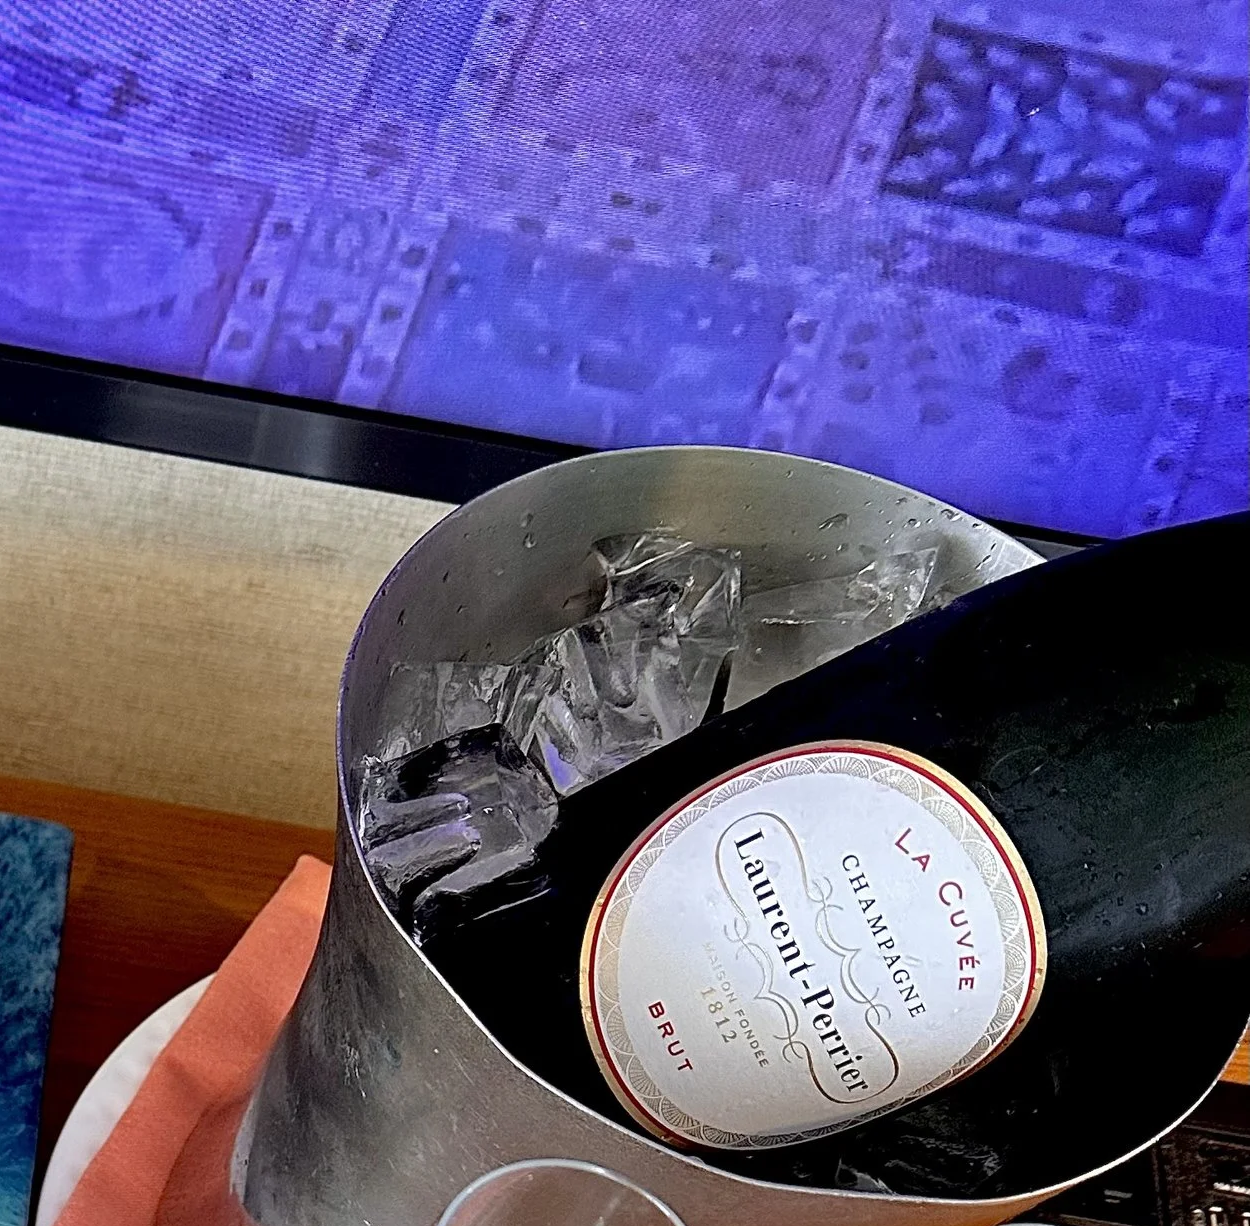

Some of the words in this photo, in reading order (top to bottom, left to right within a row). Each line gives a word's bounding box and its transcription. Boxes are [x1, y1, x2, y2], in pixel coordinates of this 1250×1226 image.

[733, 827, 870, 1094] Laurent-Perrier
[842, 854, 927, 1019] CHAMPAGNE
[894, 827, 931, 873] LA
[938, 881, 980, 991] CUVÉE
[648, 1001, 693, 1073] BRUT
[701, 986, 737, 1043] 1812
[735, 1008, 769, 1068] FONDÉE
